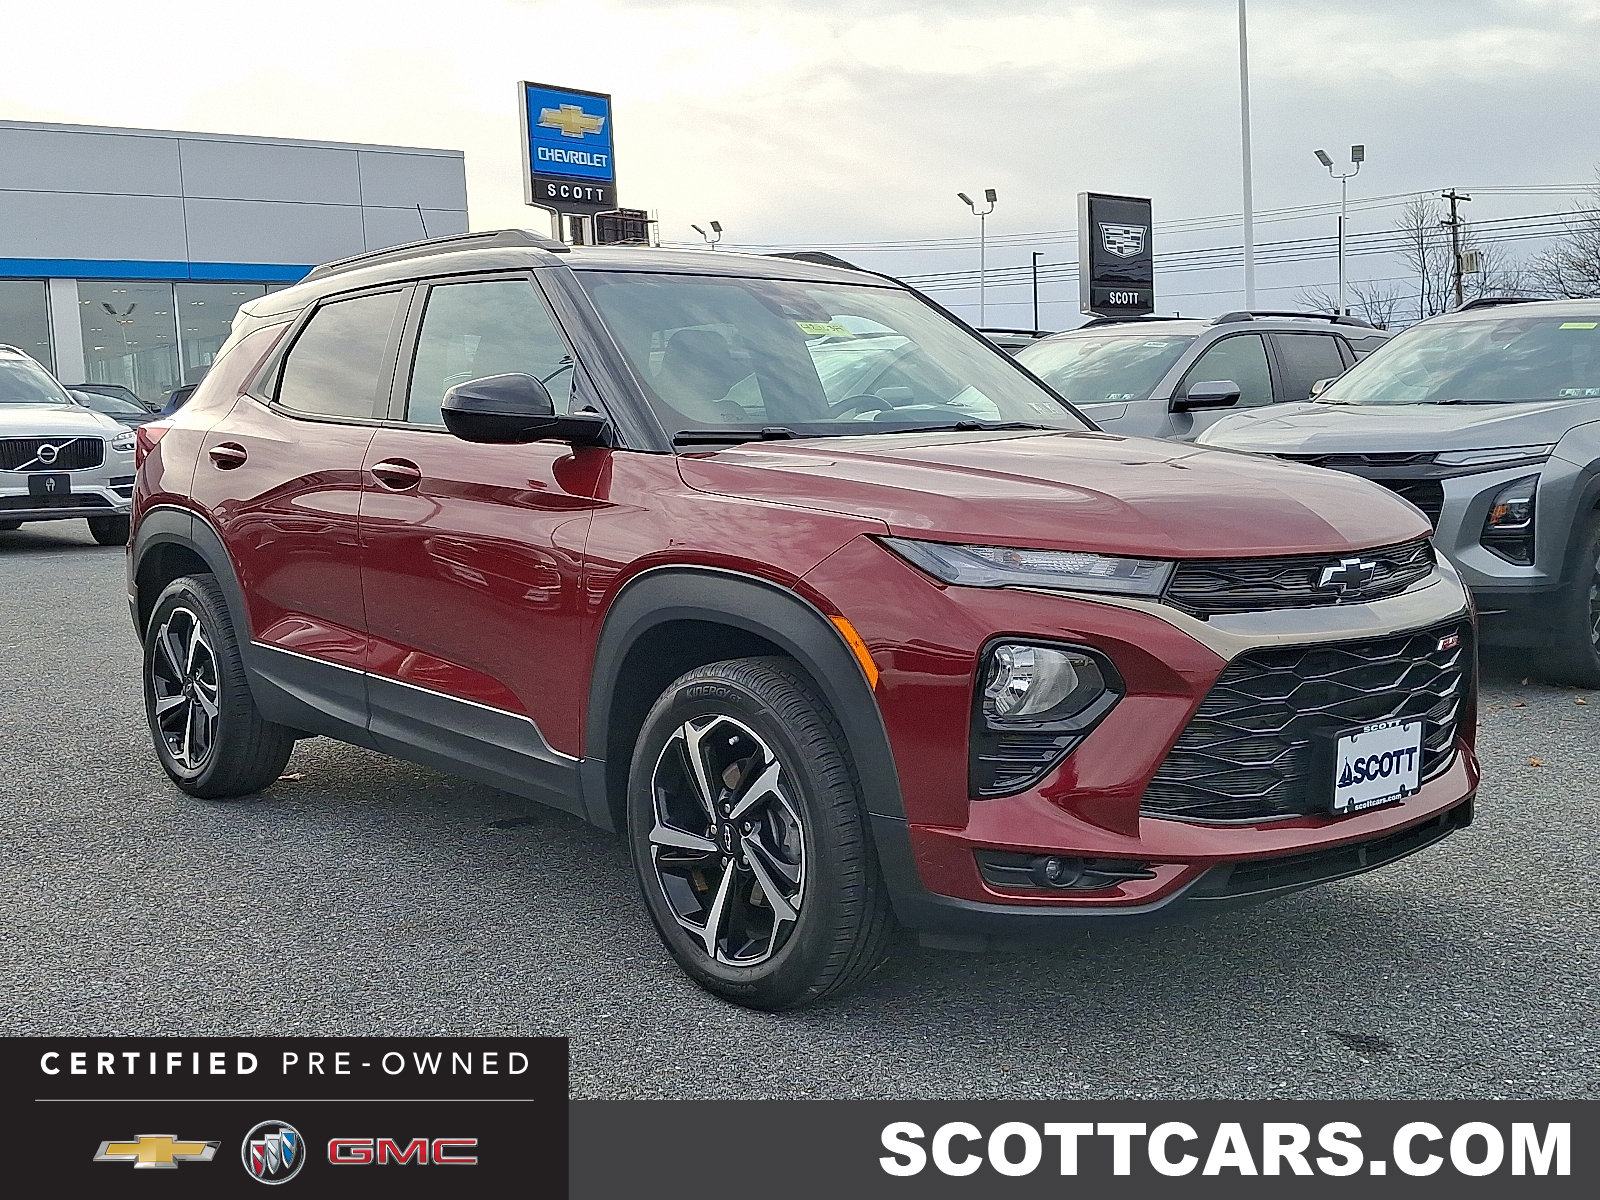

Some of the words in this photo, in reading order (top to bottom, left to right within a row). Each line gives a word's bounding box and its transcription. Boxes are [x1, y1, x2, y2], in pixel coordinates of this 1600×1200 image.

[538, 147, 608, 167] CHEVROLET
[547, 183, 604, 201] SCOTT
[1109, 291, 1139, 304] SCOTT
[1363, 719, 1402, 733] SCOTT
[1353, 746, 1418, 785] SCOTT
[1354, 793, 1402, 811] scottcars.com
